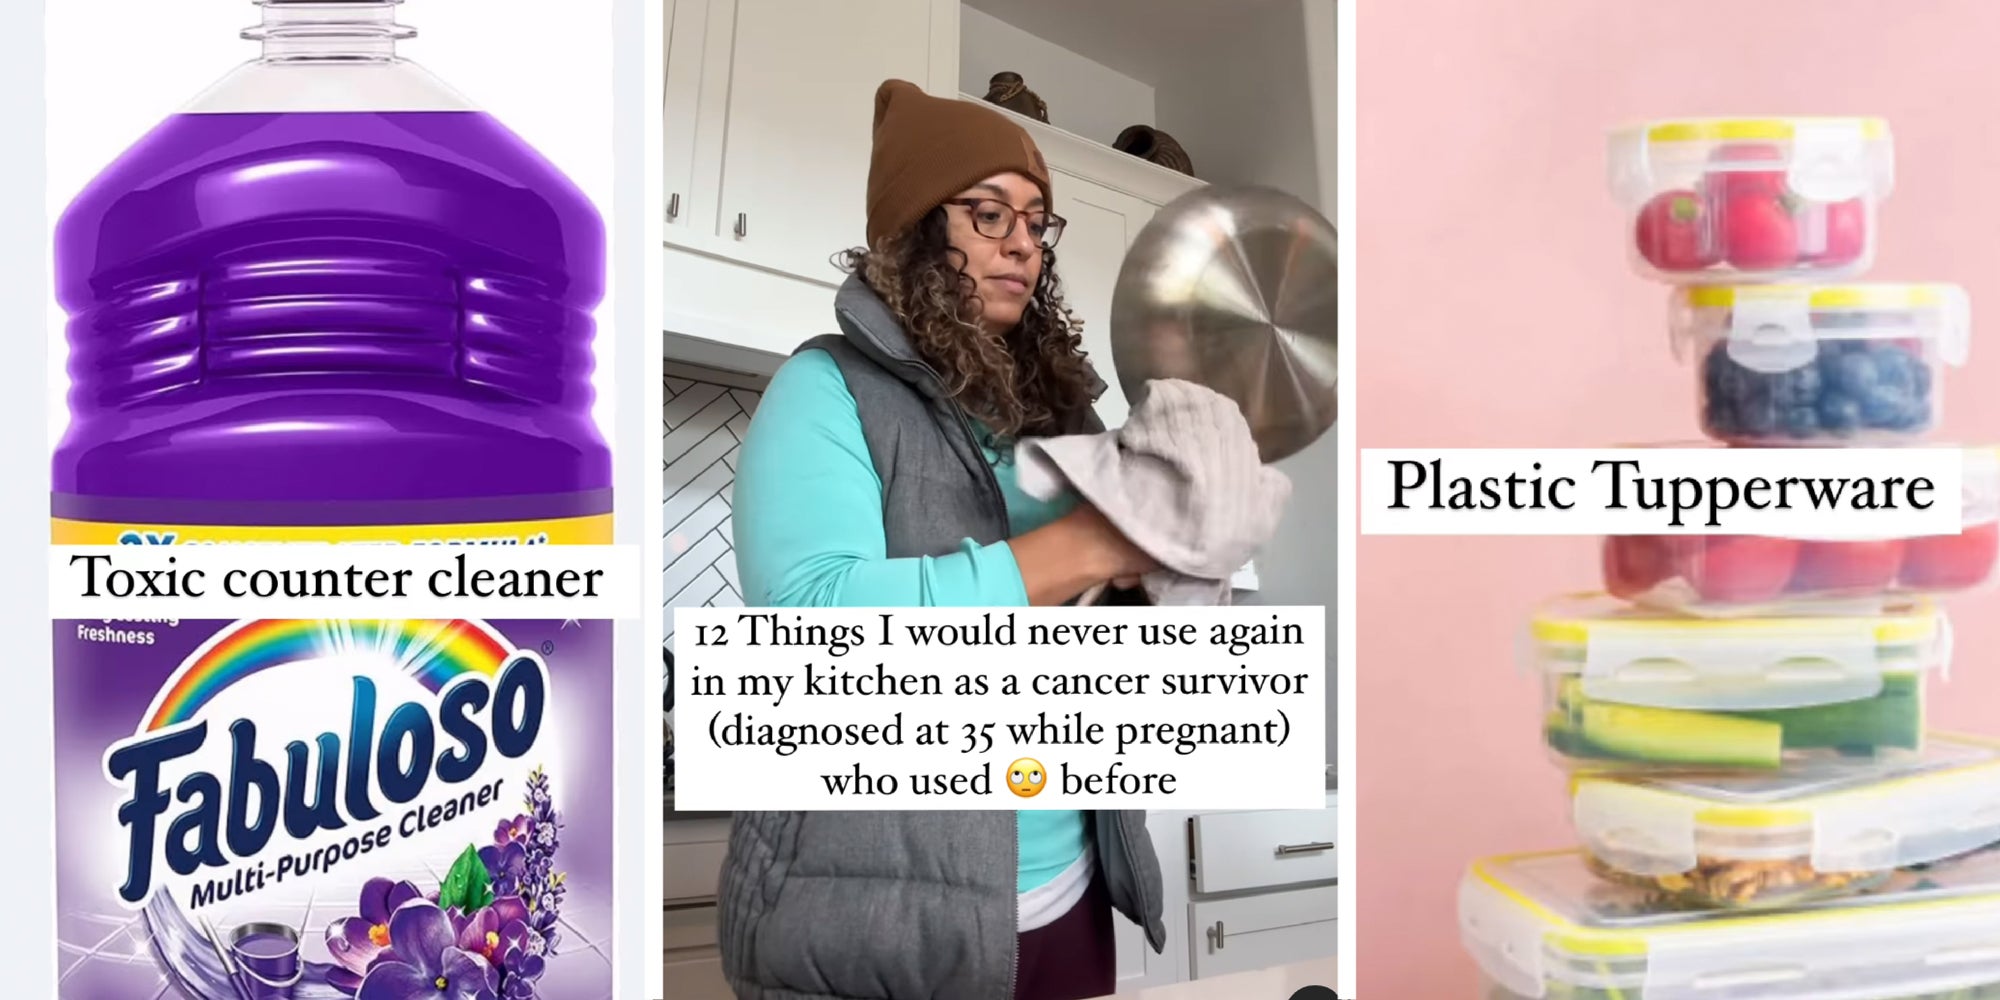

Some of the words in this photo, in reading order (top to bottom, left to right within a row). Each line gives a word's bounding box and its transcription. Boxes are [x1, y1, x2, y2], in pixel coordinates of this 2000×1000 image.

[77, 624, 155, 645] Freshness
[108, 656, 545, 901] Fabuloso
[190, 825, 391, 909] Multi-Purpose
[399, 779, 504, 838] Cleaner
